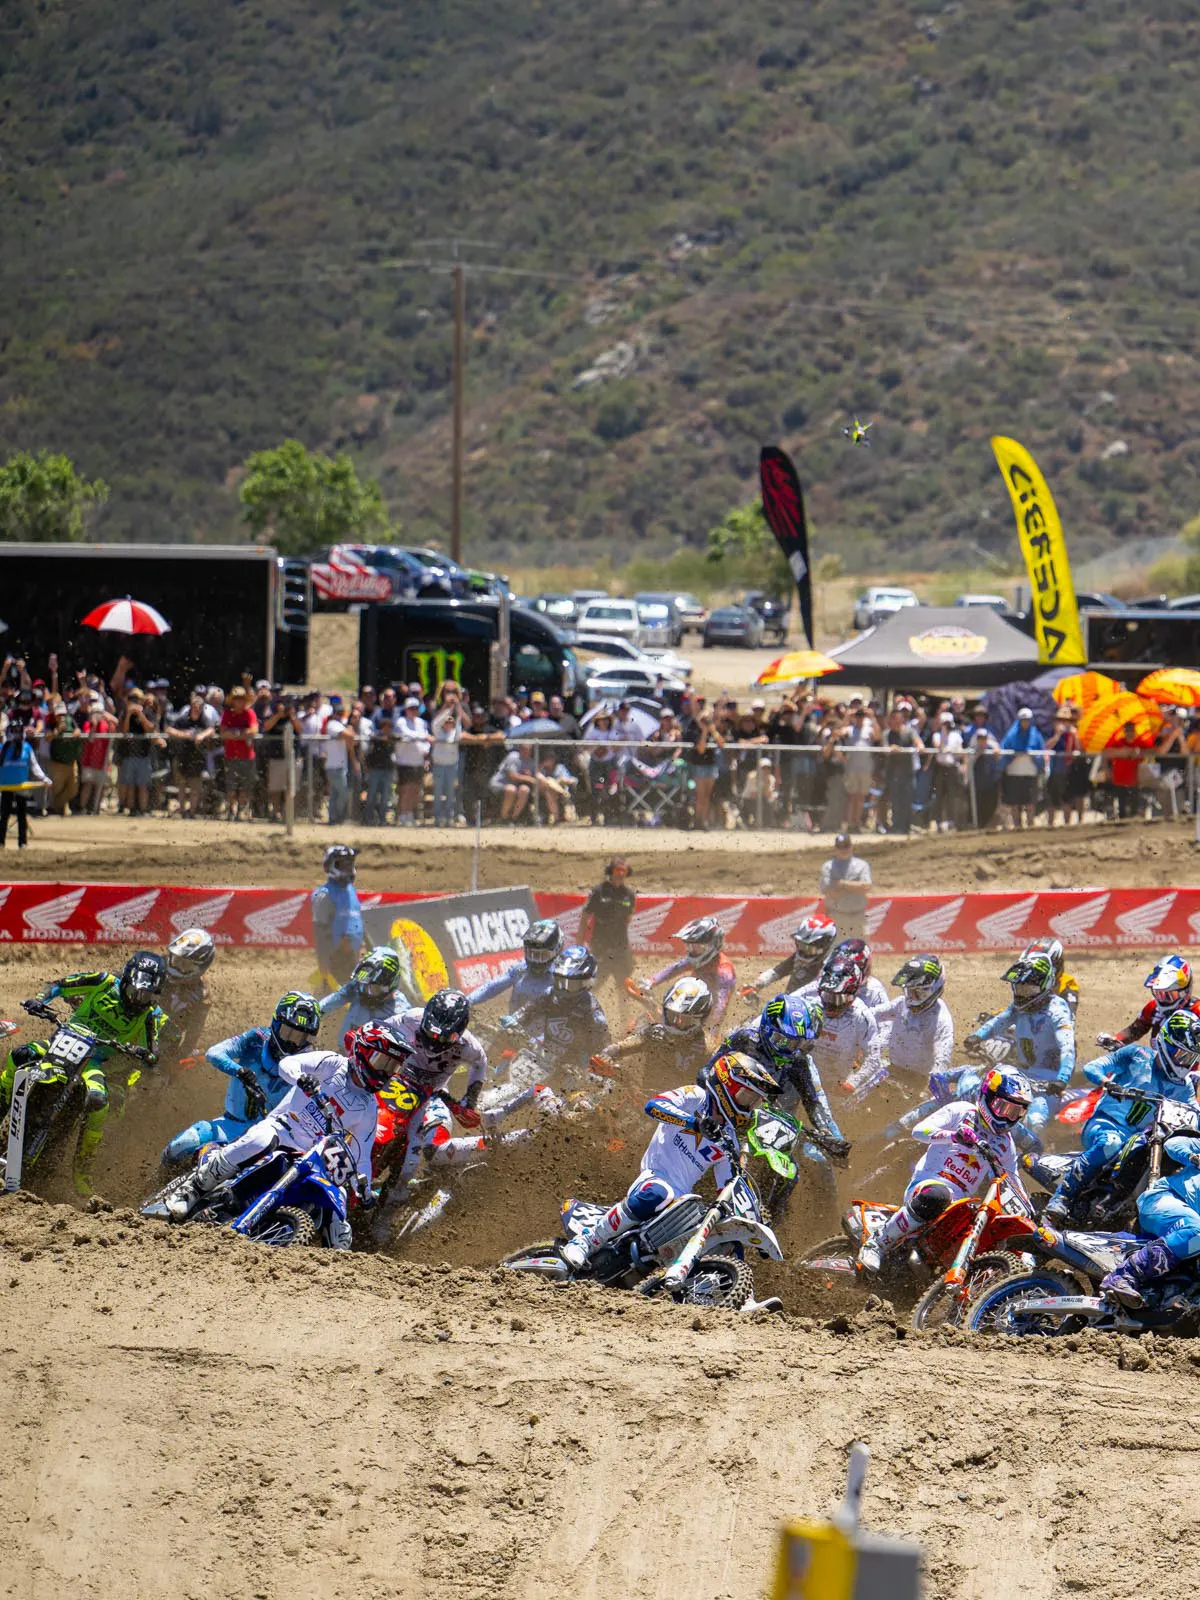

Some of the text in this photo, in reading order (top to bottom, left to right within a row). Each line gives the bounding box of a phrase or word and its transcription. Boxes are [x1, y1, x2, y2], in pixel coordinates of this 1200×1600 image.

[22, 928, 88, 941] HONDA
[243, 934, 309, 946] HONDA
[903, 939, 967, 950] HONDA
[1116, 933, 1180, 945] HONDA
[47, 1030, 92, 1065] 199
[378, 1079, 422, 1111] 30
[650, 1107, 688, 1127] ROCKSTAR
[322, 1146, 354, 1186] 43
[943, 1156, 966, 1176] Red
[961, 1168, 979, 1187] Bull
